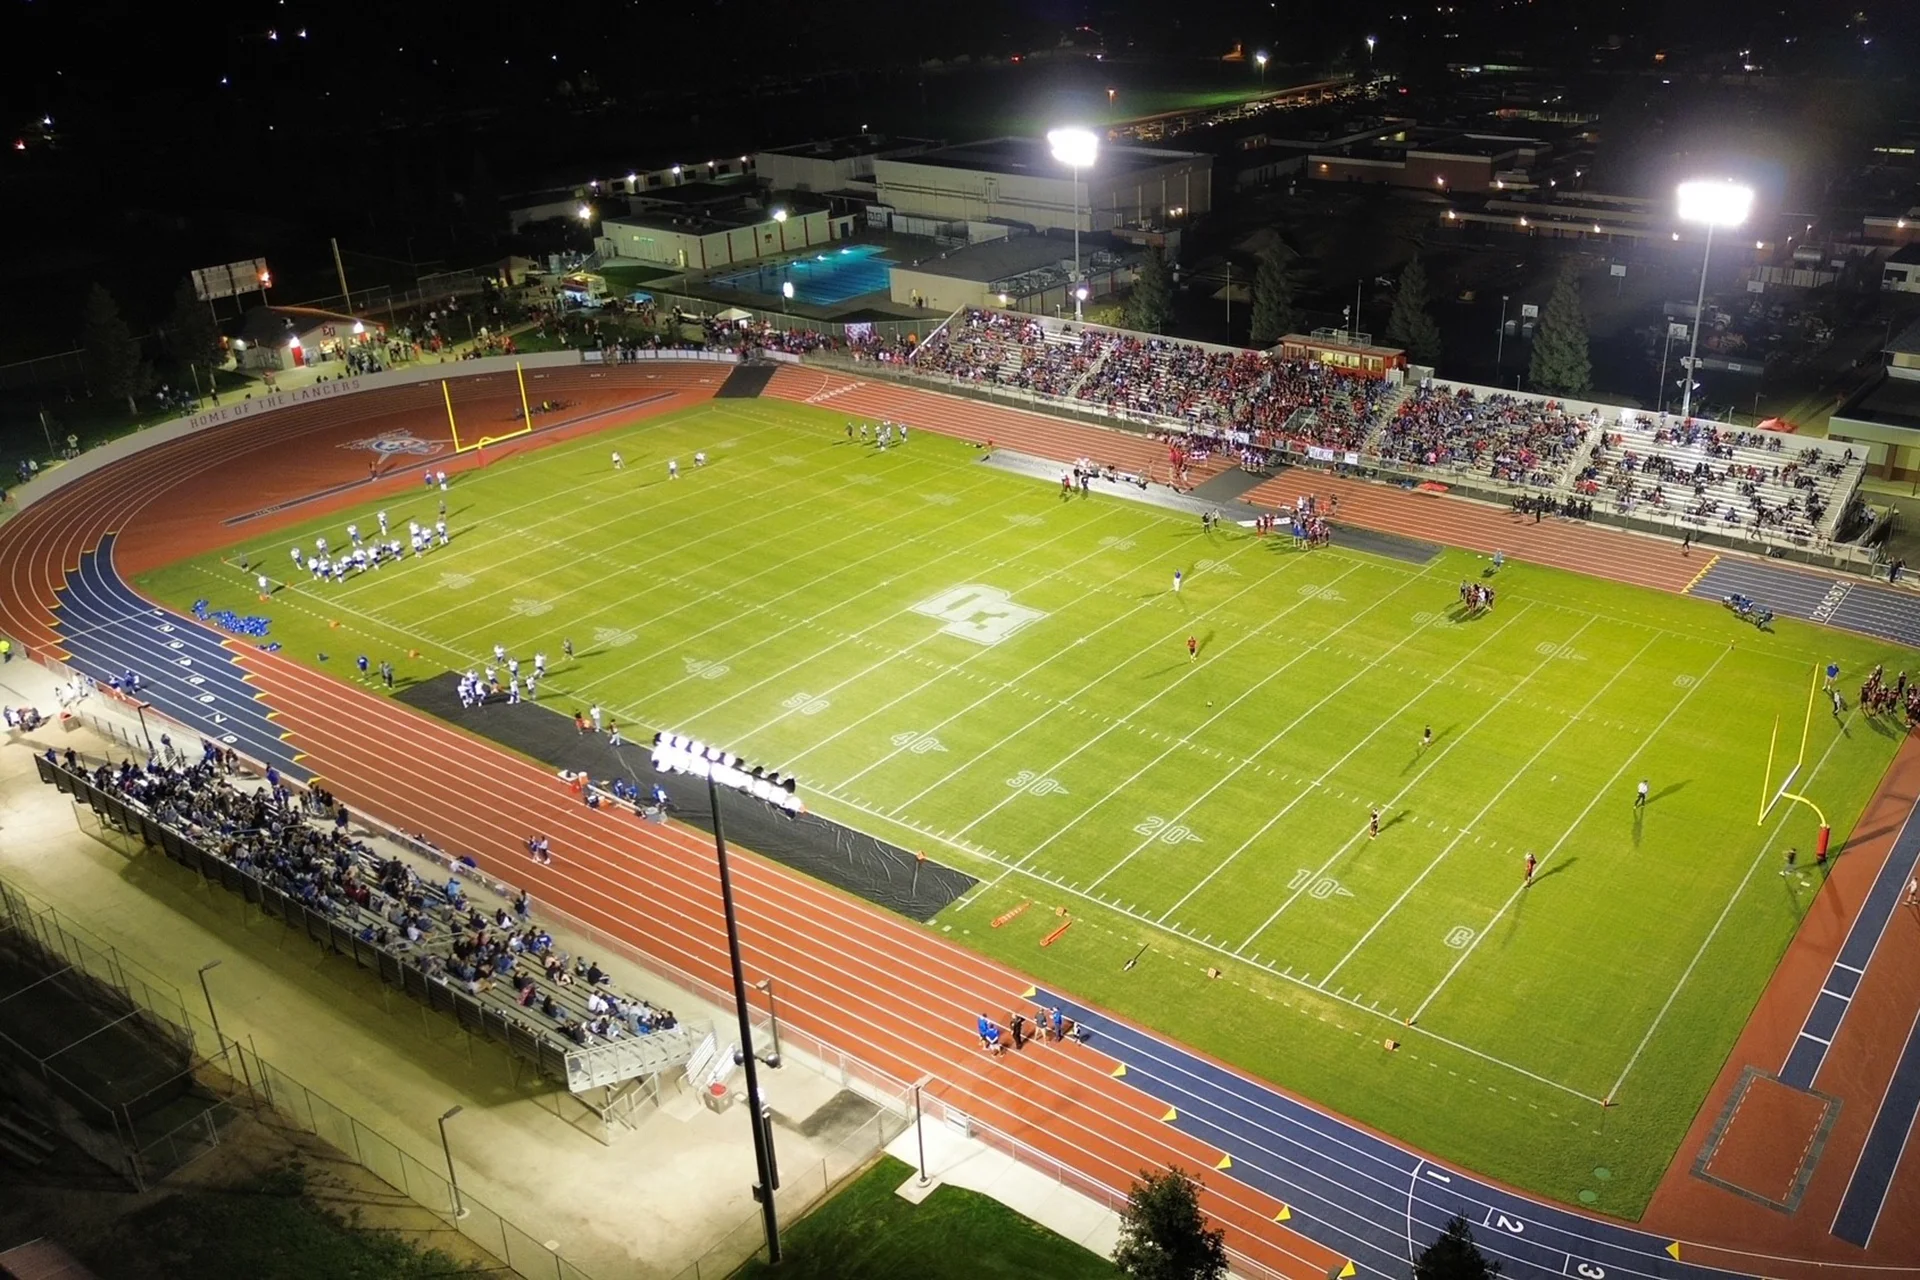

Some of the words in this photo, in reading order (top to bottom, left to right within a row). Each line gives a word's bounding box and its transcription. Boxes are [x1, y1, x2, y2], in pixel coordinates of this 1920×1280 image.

[190, 409, 228, 429] HOME
[234, 403, 250, 416] OF
[258, 395, 285, 409] THE
[292, 380, 360, 401] LANCERS
[782, 692, 830, 715] 50
[890, 731, 939, 754] 40
[1006, 770, 1059, 797] 30
[1133, 816, 1191, 844] 20
[1287, 869, 1340, 900] 10
[1444, 925, 1475, 949] G
[1427, 1170, 1450, 1183] 1
[1497, 1215, 1524, 1233] 2
[1577, 1263, 1605, 1280] 3
